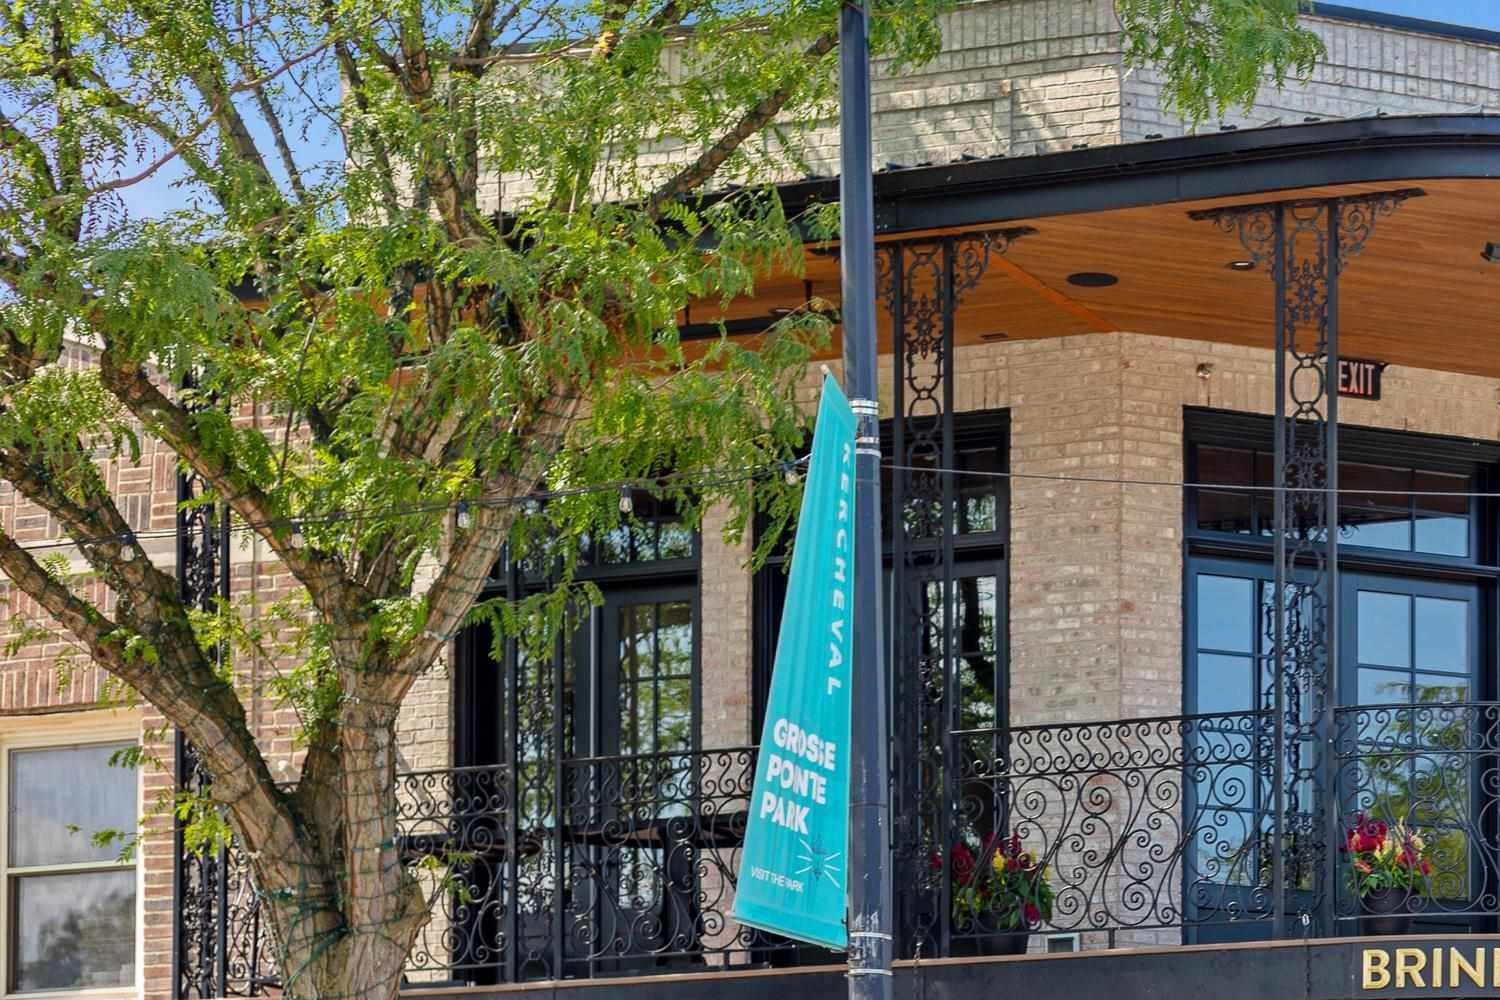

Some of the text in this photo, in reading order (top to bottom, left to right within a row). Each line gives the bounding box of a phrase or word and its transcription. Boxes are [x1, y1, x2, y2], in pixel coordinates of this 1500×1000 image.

[1338, 360, 1375, 395] EXIT
[827, 442, 850, 695] KERCHEVAL
[766, 754, 826, 804] PONTE
[760, 791, 810, 834] PARK
